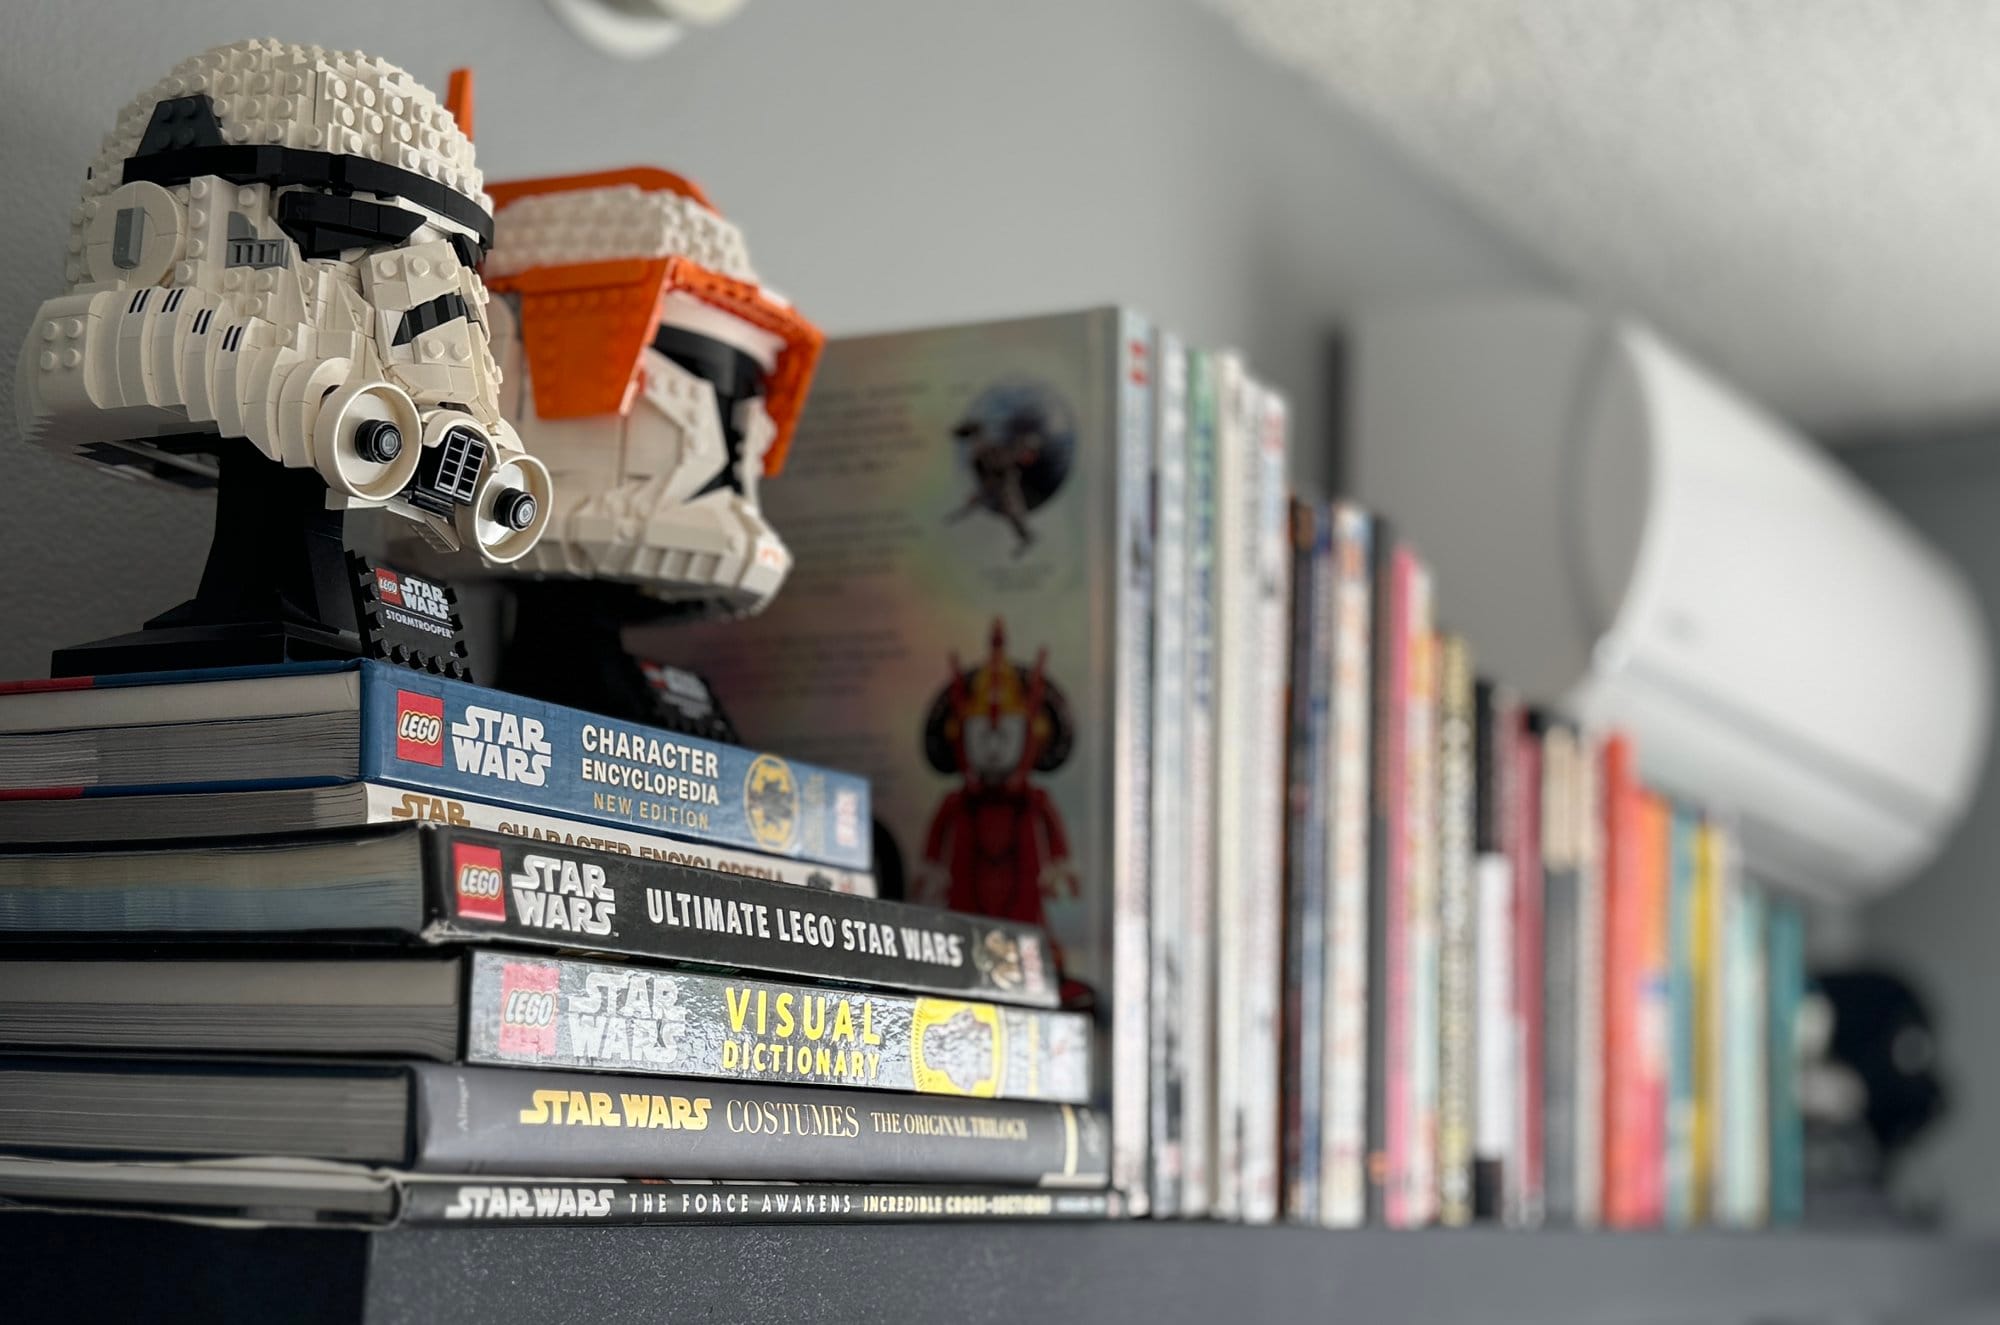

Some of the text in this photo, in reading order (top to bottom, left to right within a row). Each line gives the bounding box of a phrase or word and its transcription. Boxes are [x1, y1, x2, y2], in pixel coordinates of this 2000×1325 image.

[378, 577, 398, 595] LEGO
[400, 576, 448, 605] STAR
[402, 594, 450, 620] WARS
[386, 609, 452, 639] STORMTROOPER
[401, 712, 440, 743] LEGO
[452, 705, 551, 755] STAR
[452, 736, 551, 787] WARS
[582, 724, 719, 779] CHARACTER
[582, 758, 719, 806] ENCYCLOPEDIA
[392, 793, 471, 827] STAR
[593, 791, 709, 831] NEW EDITION
[461, 867, 500, 898] LEGO
[511, 854, 615, 901] STAR
[512, 888, 616, 936] WARS
[646, 888, 770, 939] ULTIMATE
[843, 920, 898, 958] STAR
[900, 927, 963, 968] WARS
[505, 991, 555, 1025] LEGO
[568, 971, 685, 1022] STAR
[725, 987, 881, 1045] VISUAL
[569, 1012, 685, 1063] WARS
[722, 1041, 880, 1079] DICTIONARY
[520, 1089, 620, 1127] STAR
[620, 1093, 712, 1130] WARS
[726, 1100, 860, 1138] COSTUMES
[871, 1112, 901, 1134] THE
[904, 1114, 971, 1137] ORIGINAL
[446, 1187, 534, 1219] STAR
[534, 1188, 614, 1218] WARS
[630, 1193, 666, 1213] THE
[682, 1193, 749, 1213] FORCE
[761, 1194, 850, 1213] AWAKENS
[863, 1195, 942, 1214] INCREDIBLE
